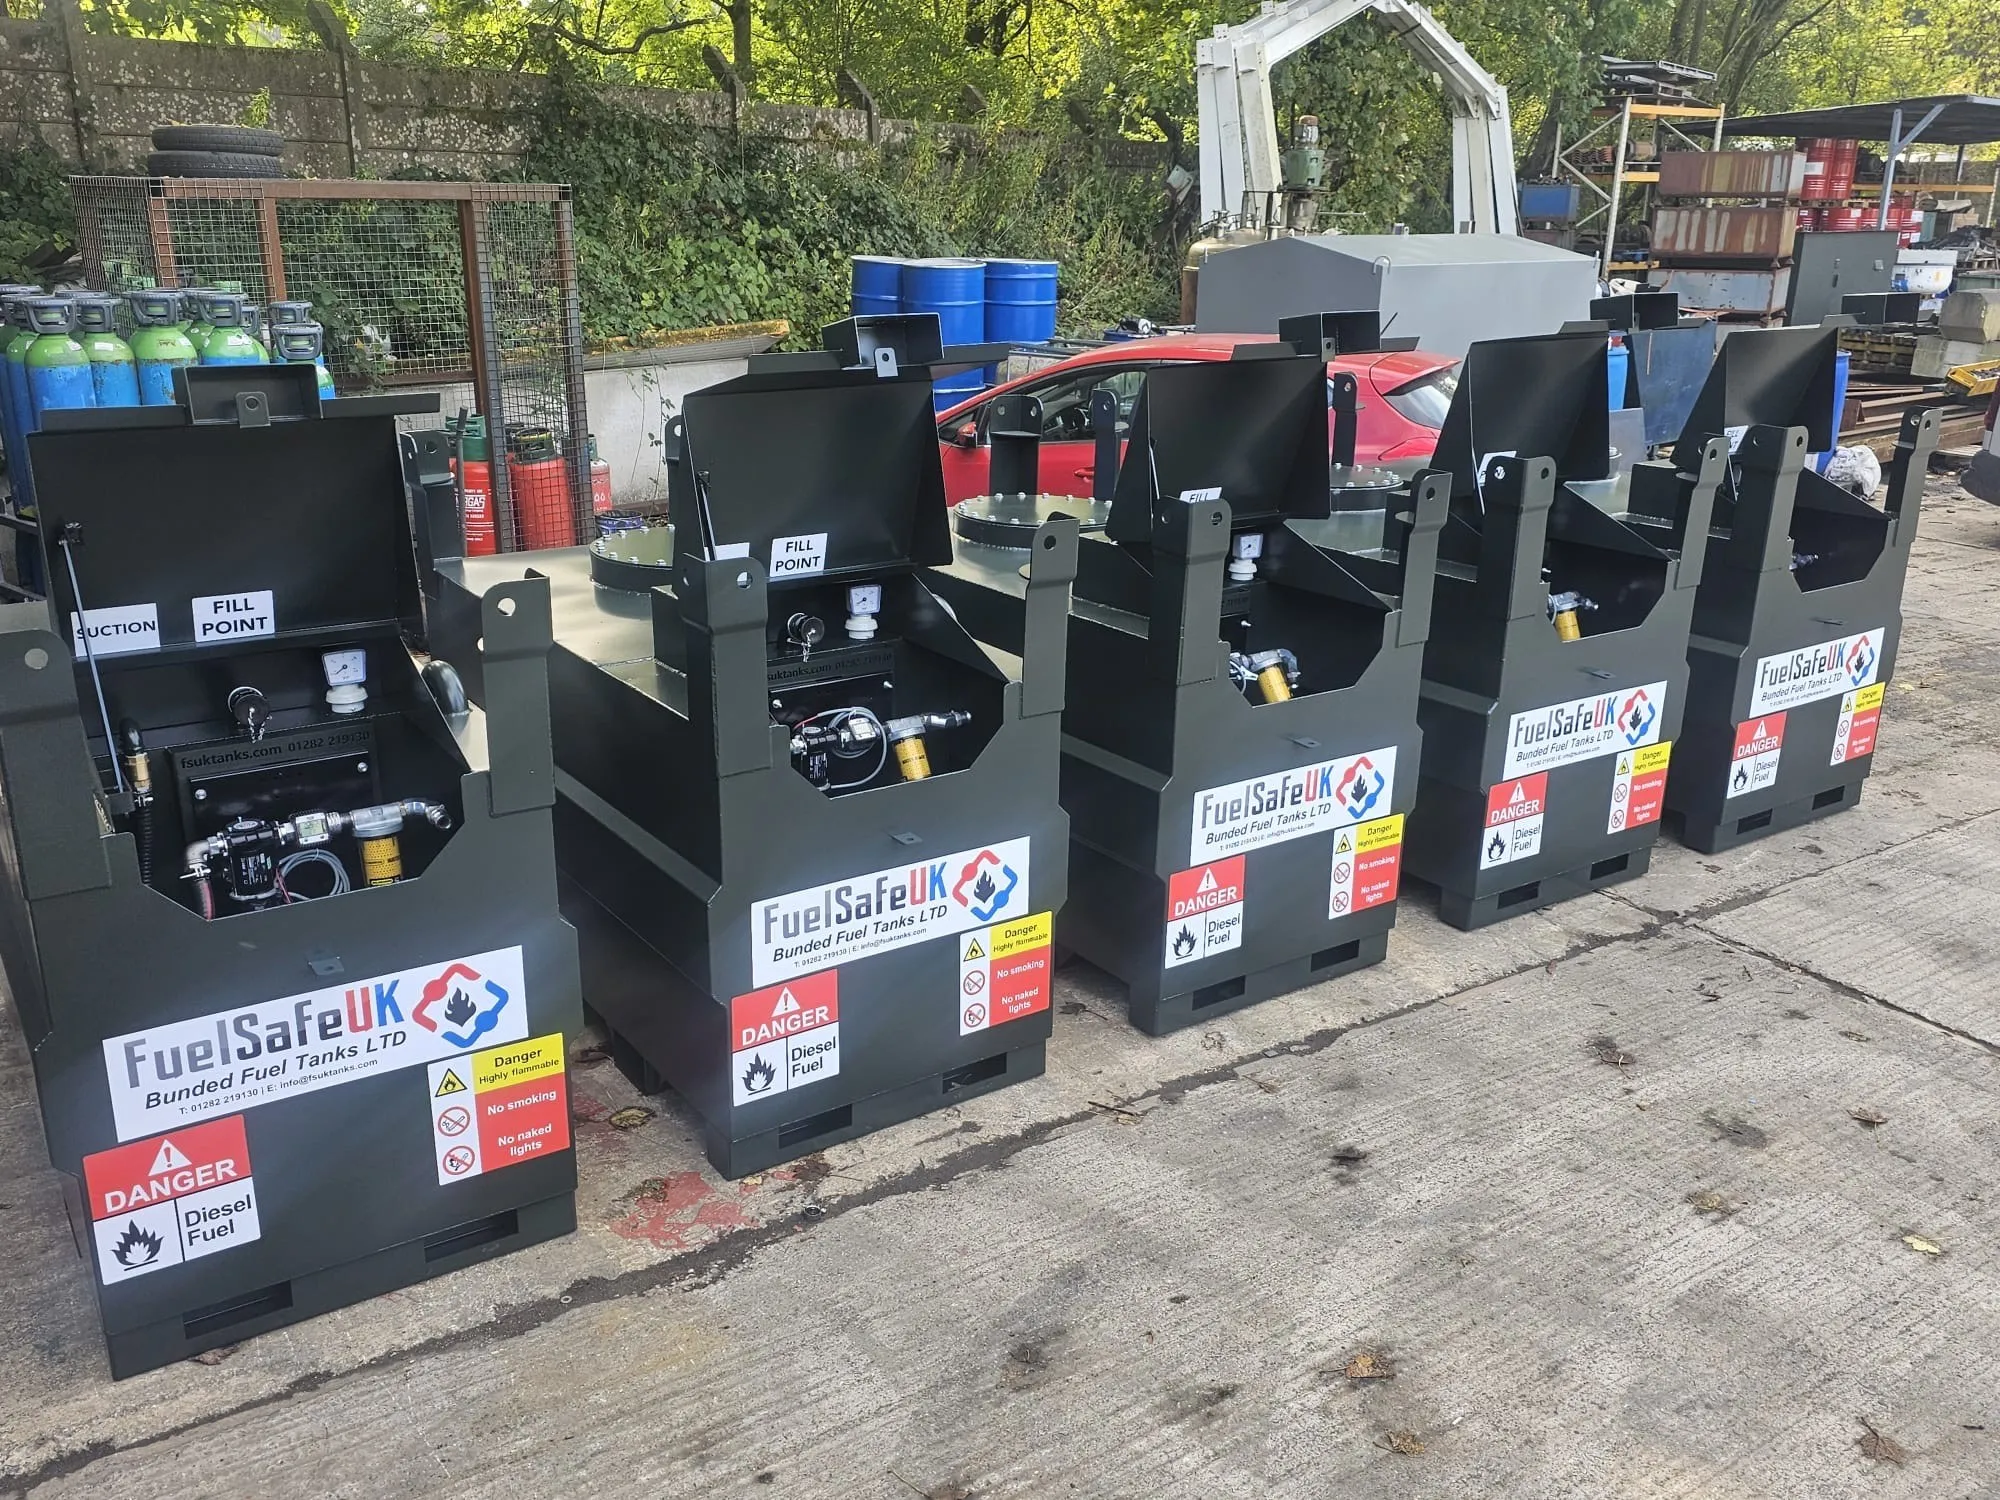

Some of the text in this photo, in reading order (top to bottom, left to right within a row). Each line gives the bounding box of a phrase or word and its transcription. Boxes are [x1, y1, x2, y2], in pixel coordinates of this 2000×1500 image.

[786, 540, 813, 552] FILL
[775, 555, 821, 572] POINT
[213, 598, 254, 614] FILL
[77, 620, 156, 640] SUCTION
[203, 616, 268, 636] POINT
[1760, 641, 1847, 688] FuelSafeUK
[1514, 695, 1618, 747] FuelSafeUK
[181, 731, 370, 769] fsuktanks.com 01282 219130
[1516, 744, 1549, 762] Bunded
[1550, 740, 1568, 754] Fuel
[1571, 734, 1595, 748] Tanks
[1596, 729, 1614, 742] LTD
[1737, 735, 1779, 758] DANGER
[1201, 764, 1334, 829] FuelSafeUK
[1490, 799, 1540, 824] DANGER
[1205, 802, 1332, 845] Bunded Fuel Tanks LTD
[1367, 824, 1392, 836] Danger
[1515, 823, 1541, 840] Diesel
[1514, 838, 1532, 853] Fuel
[1358, 855, 1395, 871] No smoking
[1361, 885, 1370, 894] No
[764, 861, 947, 945] FuelSafeUK
[1175, 886, 1237, 917] DANGER
[773, 904, 948, 963] Bunded Fuel Tanks LTD
[1004, 924, 1038, 939] Danger
[1208, 912, 1241, 933] Diesel
[993, 932, 1048, 953] Highly flammable
[1207, 930, 1231, 947] Fuel
[996, 959, 1045, 979] No smoking
[1001, 986, 1039, 1005] No naked
[1008, 1000, 1032, 1014] lights
[124, 979, 404, 1089] FuelSafeUK
[742, 1005, 829, 1046] DANGER
[494, 1049, 542, 1068] Danger
[791, 1035, 836, 1062] Diesel
[146, 1030, 407, 1110] Bunded Fuel Tanks LTD
[479, 1059, 560, 1084] Highly flammable
[792, 1056, 823, 1078] Fuel
[179, 1106, 188, 1115] T:
[191, 1098, 220, 1113] 01282
[224, 1088, 258, 1105] 219130
[267, 1083, 277, 1093] E:
[280, 1058, 378, 1089] info@fsuktanks.com
[487, 1090, 557, 1116] No smoking
[498, 1123, 552, 1147] No naked
[510, 1140, 542, 1157] lights
[105, 1158, 237, 1213] DANGER
[185, 1194, 252, 1228] Diesel
[188, 1219, 235, 1247] Fuel
